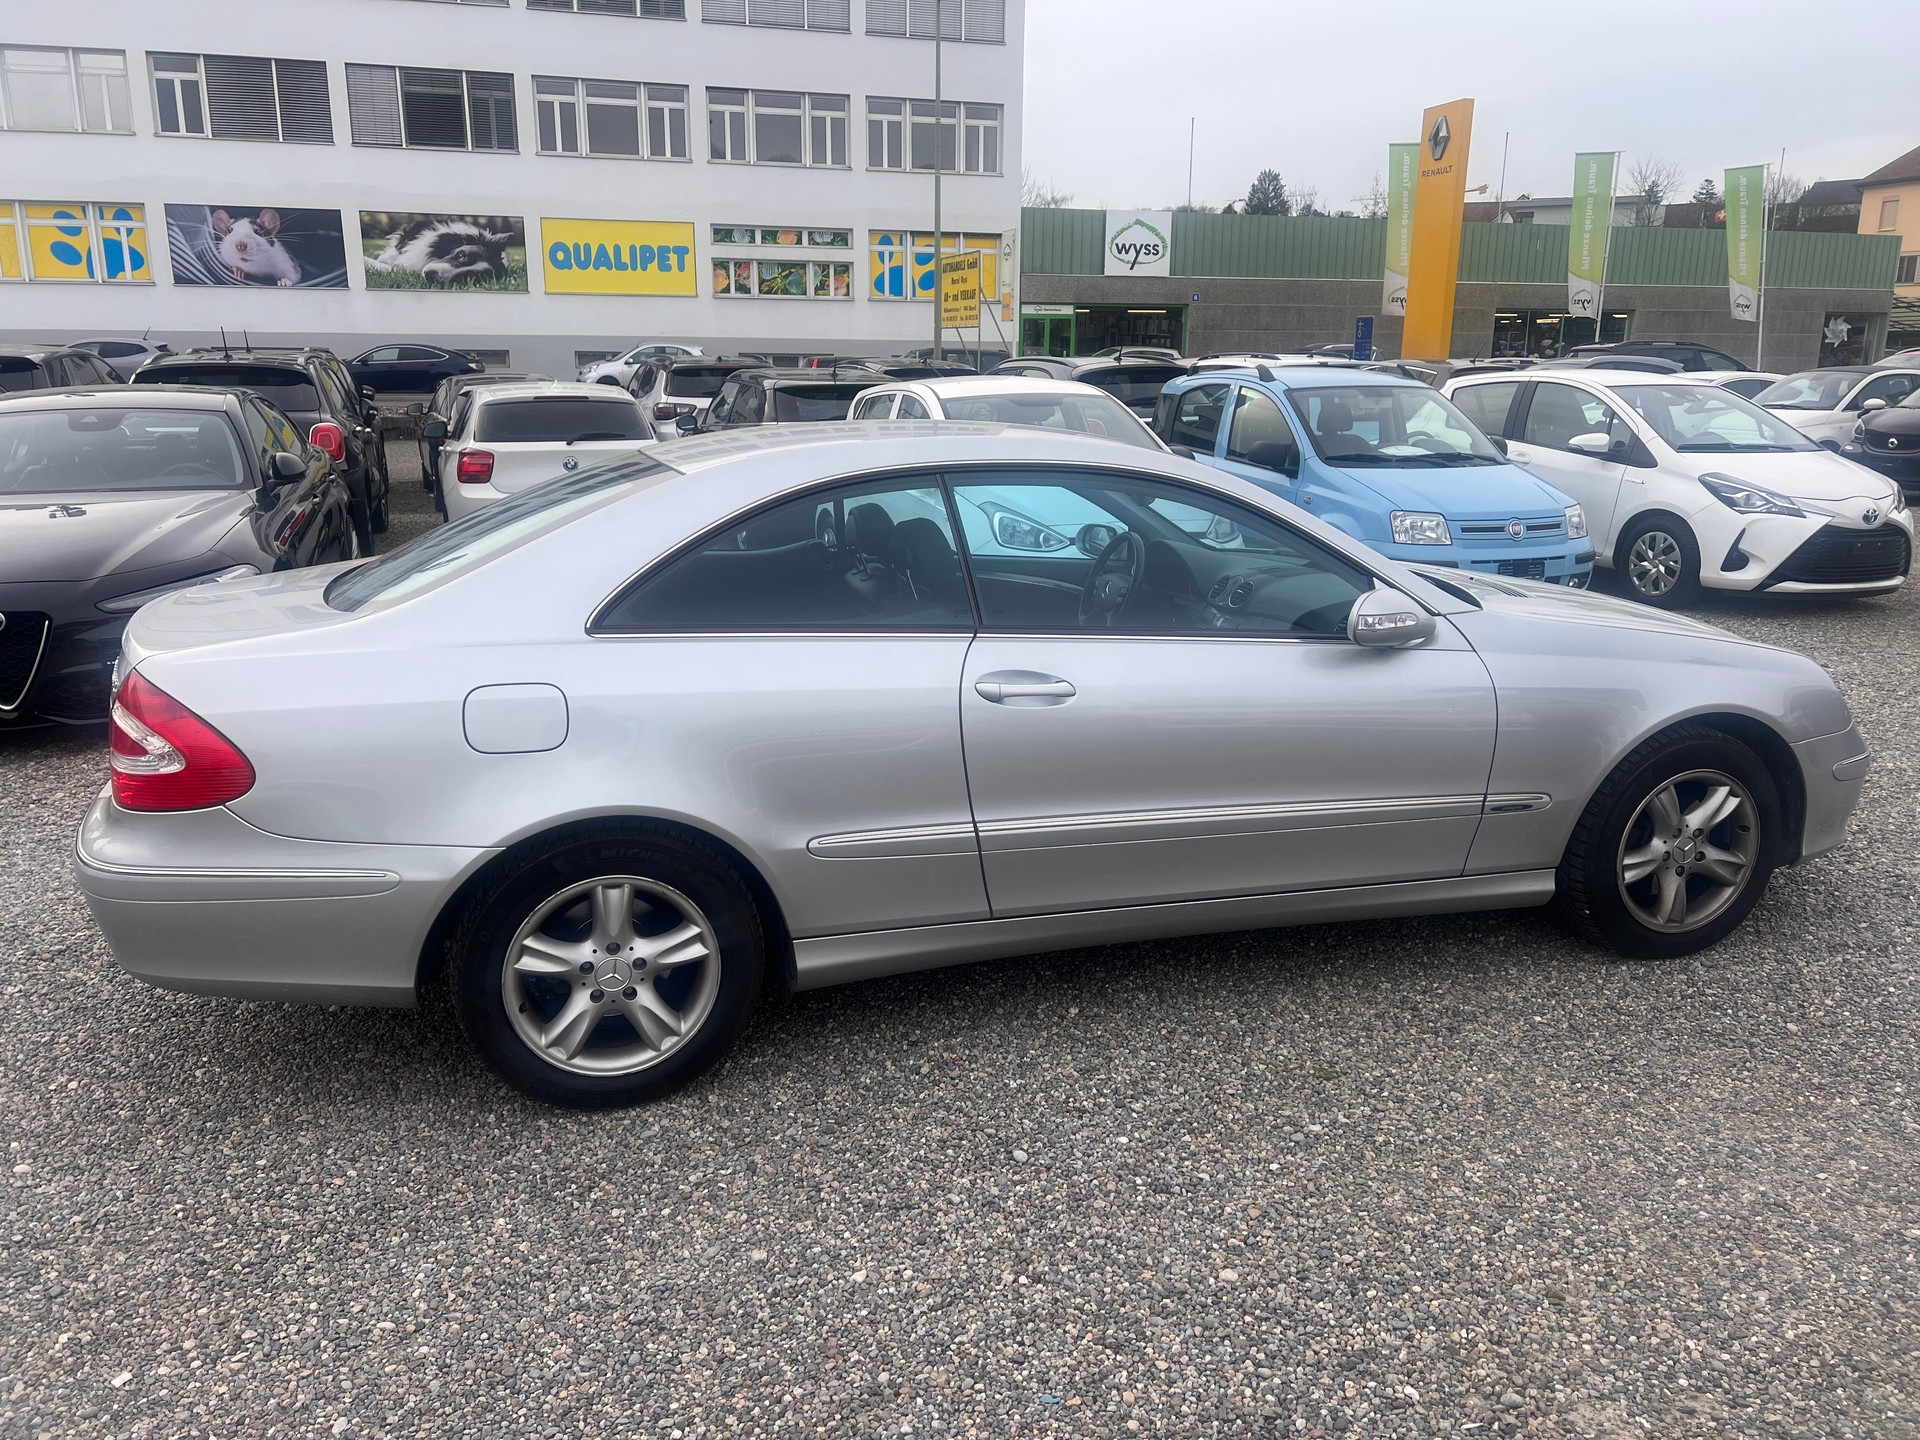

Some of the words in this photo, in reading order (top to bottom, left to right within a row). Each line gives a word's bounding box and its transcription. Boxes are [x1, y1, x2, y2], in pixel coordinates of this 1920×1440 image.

[1421, 165, 1453, 178] RENAULT
[548, 241, 690, 273] QUALIPET
[1114, 242, 1160, 271] wyss
[966, 257, 978, 270] GmbH
[960, 288, 977, 301] VERKAUF
